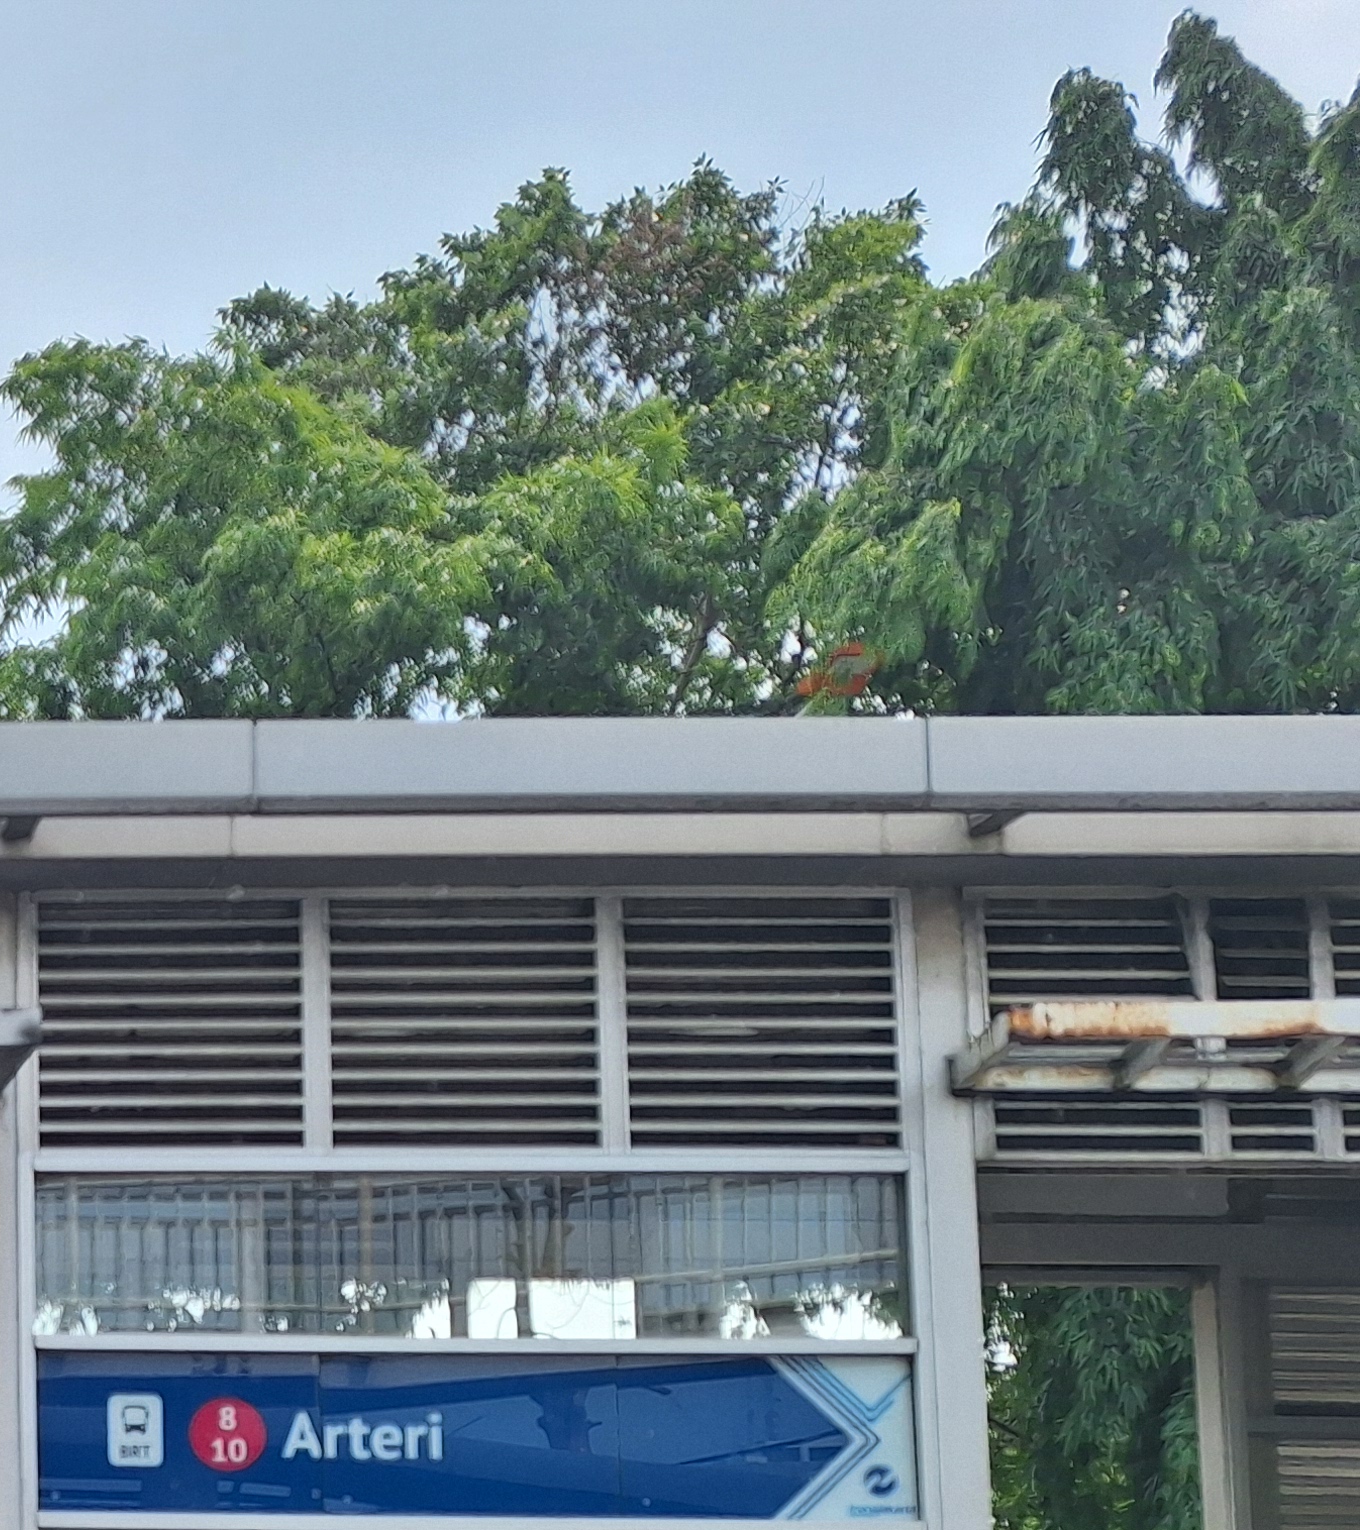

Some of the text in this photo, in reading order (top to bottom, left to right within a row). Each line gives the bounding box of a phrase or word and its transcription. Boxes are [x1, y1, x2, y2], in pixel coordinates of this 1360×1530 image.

[218, 1405, 238, 1431] 8
[281, 1410, 444, 1461] Arteri
[210, 1437, 248, 1463] 10
